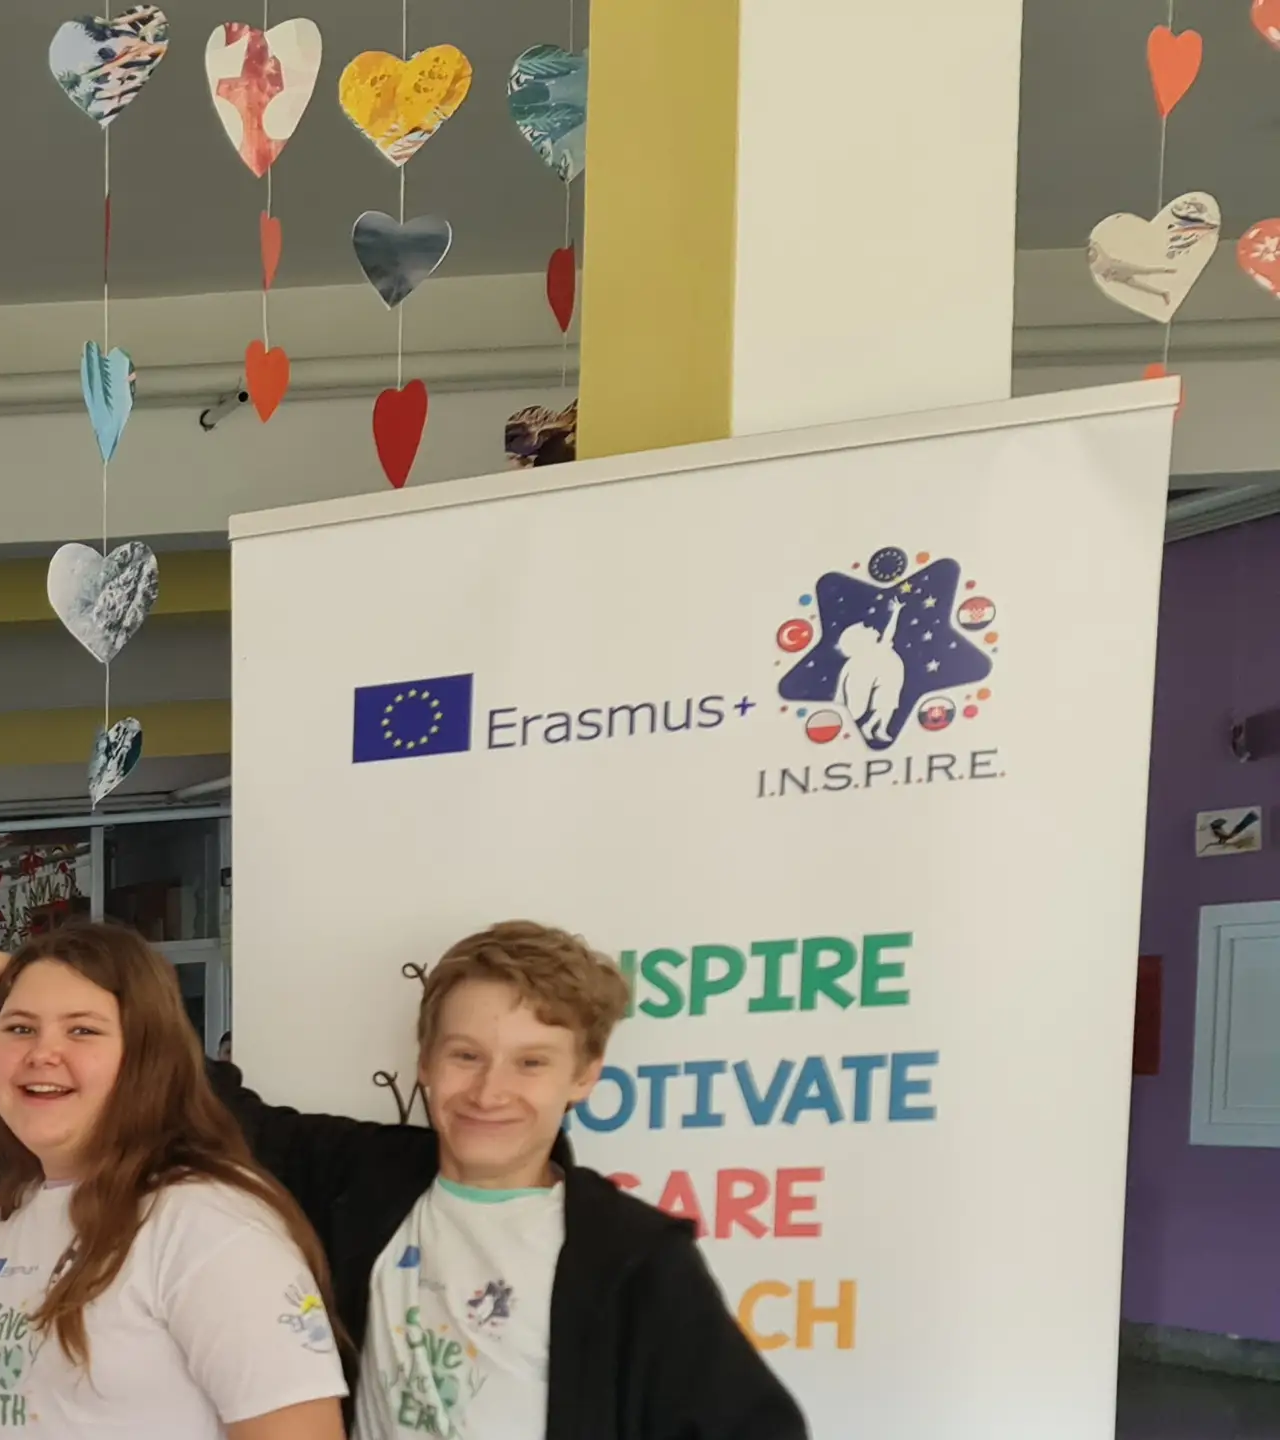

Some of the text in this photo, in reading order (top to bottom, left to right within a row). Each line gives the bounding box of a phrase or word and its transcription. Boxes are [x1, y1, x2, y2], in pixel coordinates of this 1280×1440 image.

[484, 693, 758, 751] Erasmus+
[755, 748, 1008, 800] I.N.S.P.I.R.E.
[561, 1050, 940, 1134] OTIVATE
